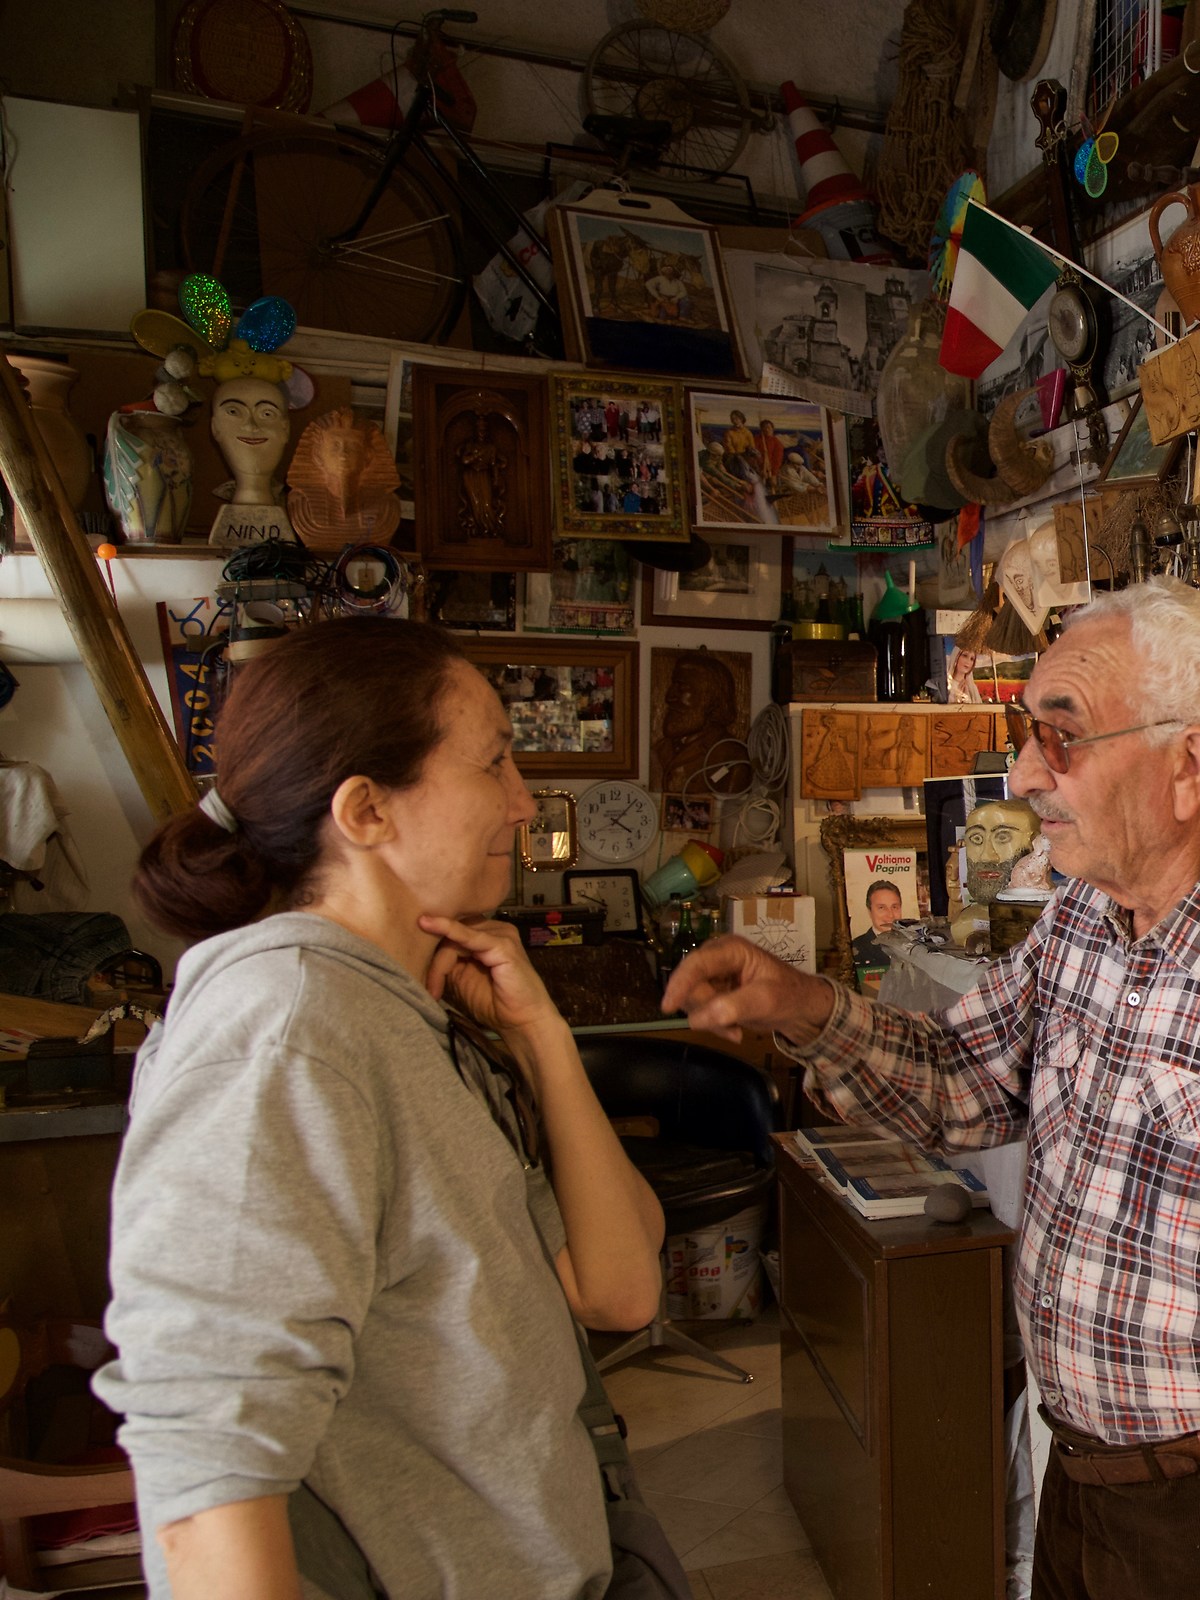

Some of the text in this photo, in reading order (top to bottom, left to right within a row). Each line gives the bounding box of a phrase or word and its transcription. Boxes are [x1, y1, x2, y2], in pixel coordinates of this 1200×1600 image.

[226, 524, 280, 540] NINO
[610, 790, 621, 800] 12
[589, 803, 599, 813] 10
[636, 802, 643, 813] 2
[584, 817, 591, 827] 9
[640, 816, 648, 826] 3
[589, 830, 596, 841] 8
[635, 829, 642, 840] 4
[612, 841, 620, 852] 6
[626, 838, 633, 849] 5
[865, 854, 912, 872] Voltiamo
[875, 863, 910, 875] Pagina
